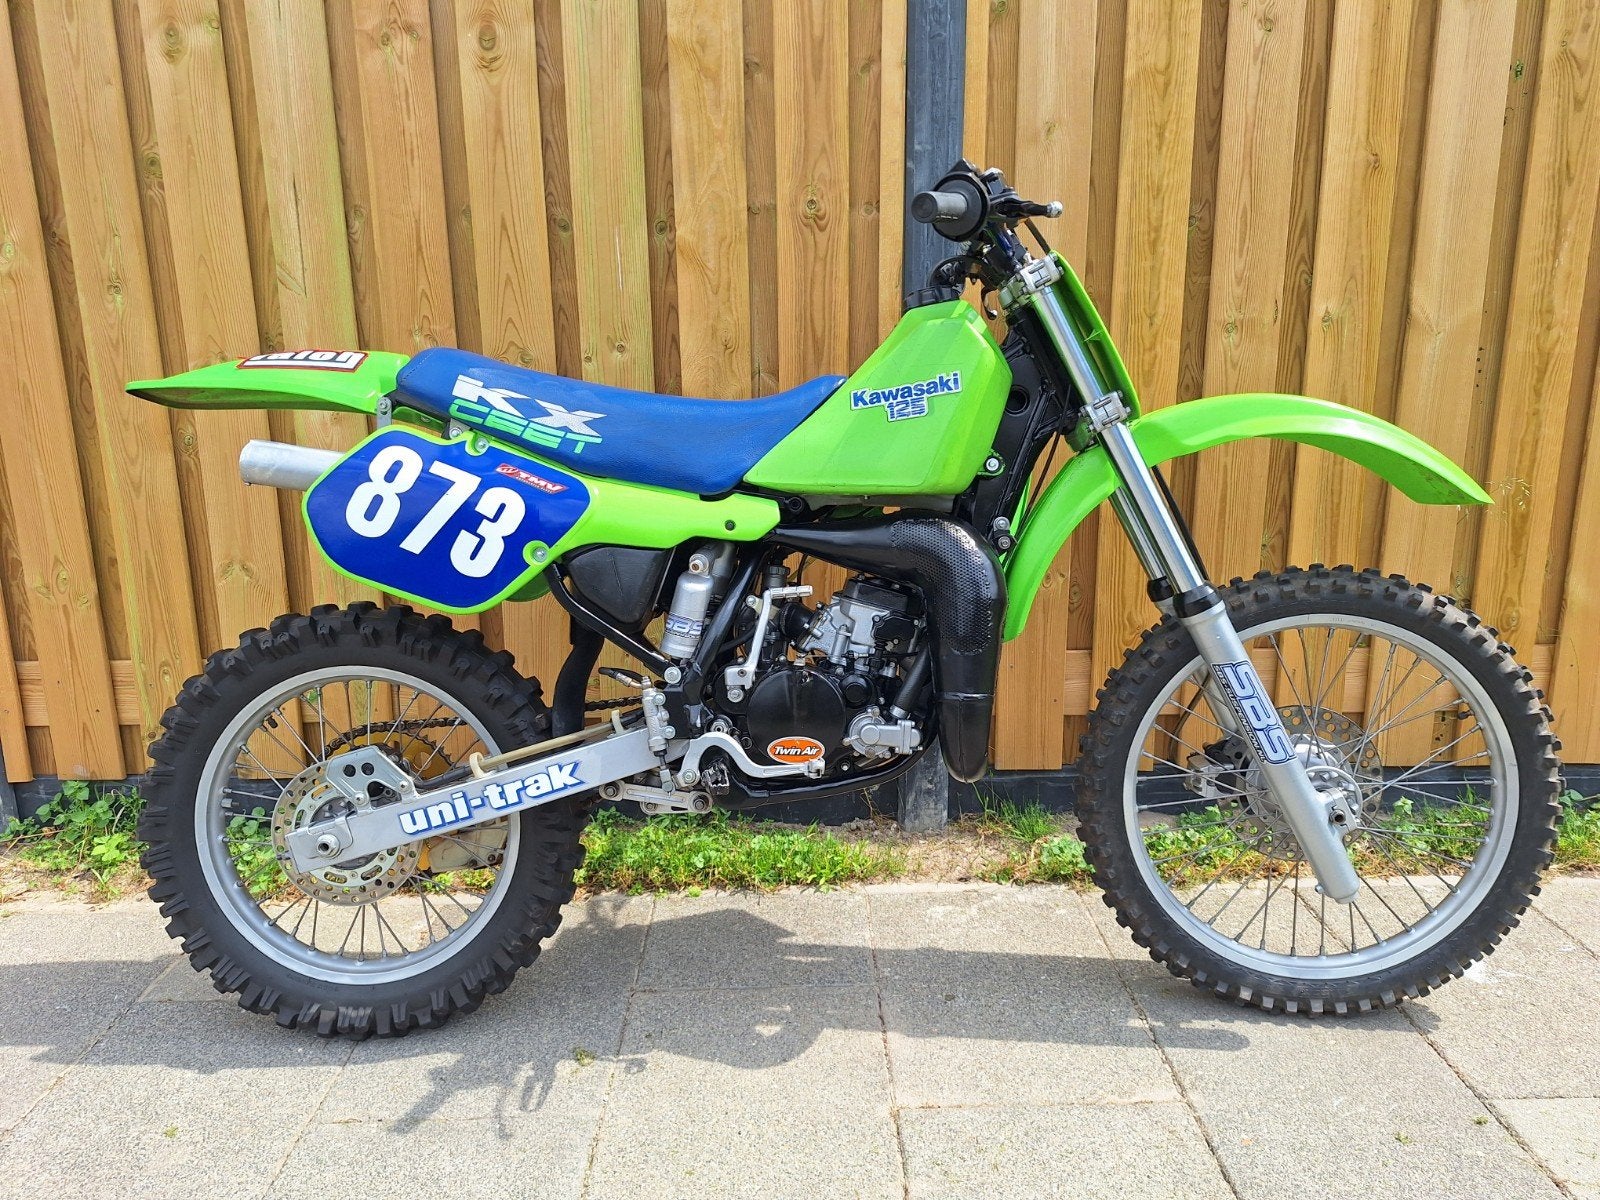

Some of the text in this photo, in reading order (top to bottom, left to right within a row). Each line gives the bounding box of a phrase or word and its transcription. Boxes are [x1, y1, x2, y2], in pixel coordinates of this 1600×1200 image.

[452, 374, 607, 437] KX
[852, 372, 961, 408] Kawasaki
[887, 397, 926, 420] 125
[449, 398, 603, 454] CEET
[518, 471, 564, 491] TMV
[345, 445, 526, 578] 873
[1221, 660, 1298, 765] SBS
[774, 745, 820, 756] Twin Air
[399, 760, 586, 836] uni-trak
